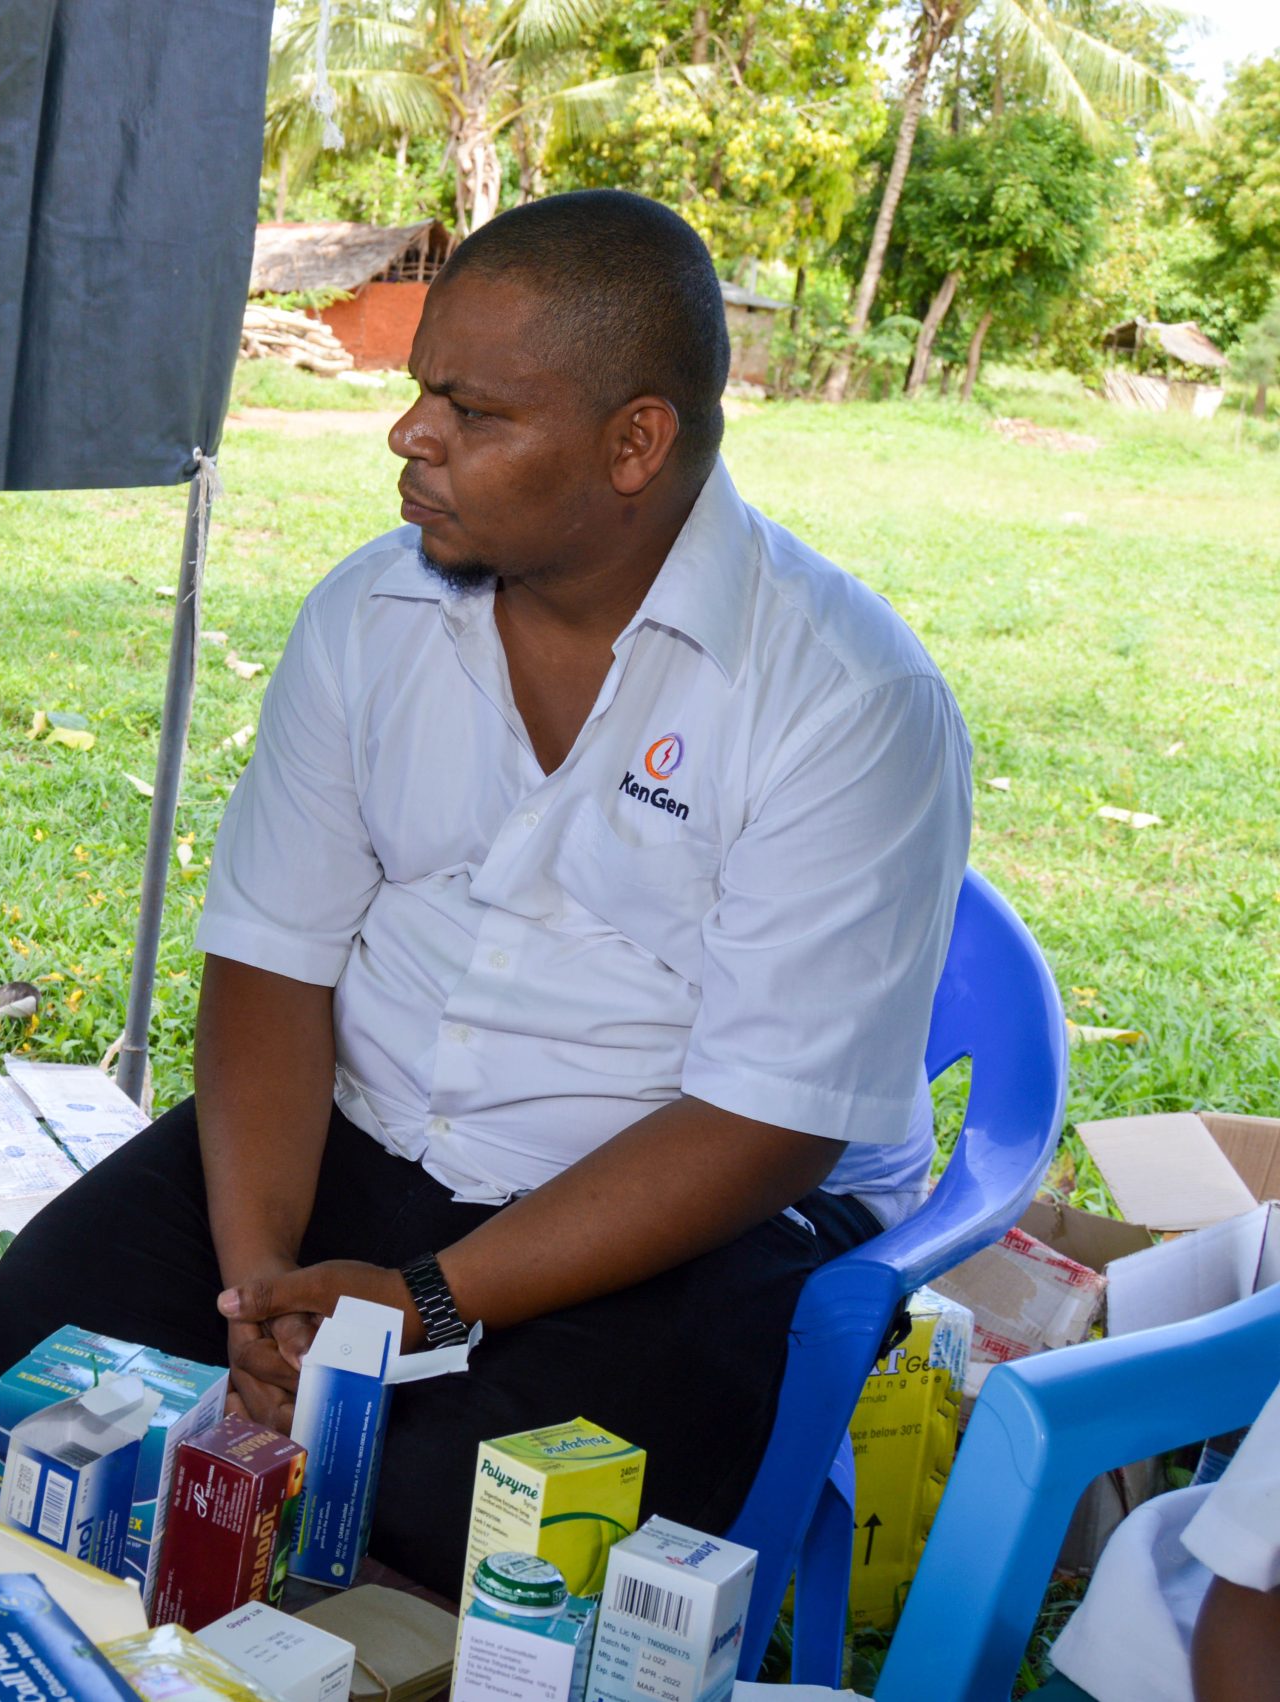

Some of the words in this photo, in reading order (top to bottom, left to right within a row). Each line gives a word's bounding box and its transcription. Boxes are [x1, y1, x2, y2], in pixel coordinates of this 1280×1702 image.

[619, 771, 689, 820] KenGen
[225, 1429, 280, 1460] PARADOL
[544, 1435, 612, 1455] Polyzyme
[480, 1458, 539, 1500] Polyzyme
[620, 1464, 640, 1478] 240ml
[249, 1503, 278, 1602] ARADOL
[600, 1636, 620, 1649] Batch
[620, 1642, 631, 1653] No
[641, 1651, 653, 1662] LJ
[652, 1655, 667, 1667] 022
[619, 1626, 630, 1637] Lic
[631, 1630, 641, 1641] No
[29, 1657, 68, 1698] Glucose
[595, 1664, 610, 1677] Exp.
[611, 1670, 626, 1682] date
[636, 1681, 656, 1694] MAR
[660, 1689, 680, 1702] 2024
[597, 1649, 613, 1663] Mfg.
[614, 1655, 629, 1667] date
[639, 1666, 656, 1679] APR
[662, 1674, 681, 1688] 2022
